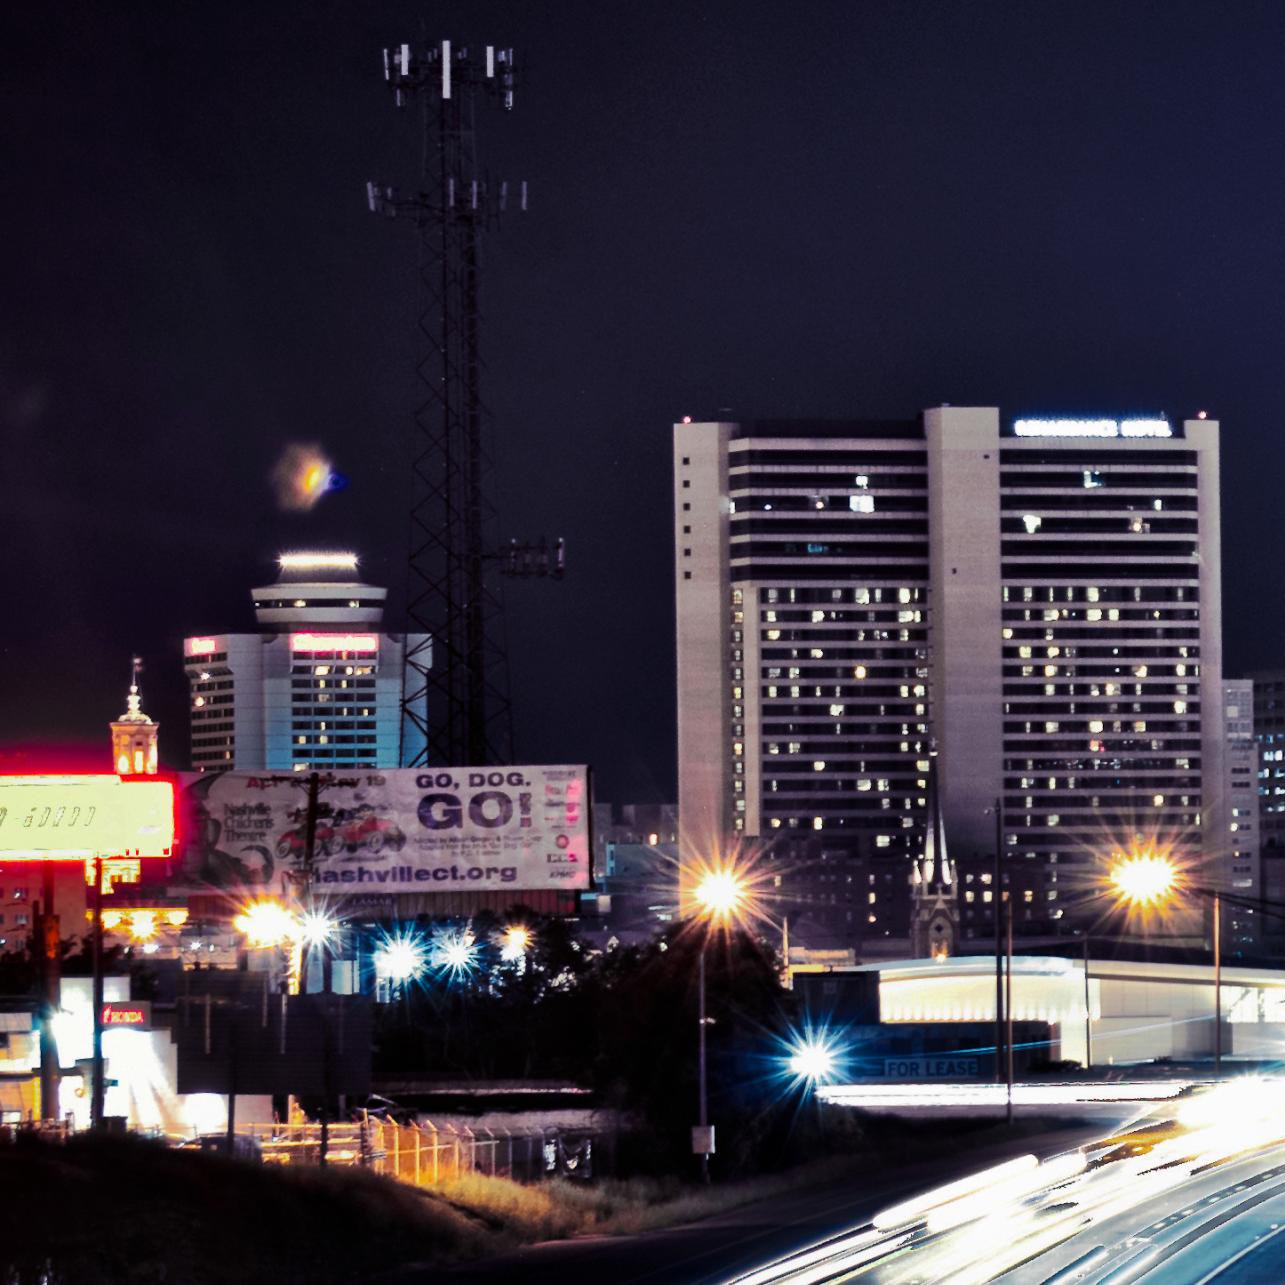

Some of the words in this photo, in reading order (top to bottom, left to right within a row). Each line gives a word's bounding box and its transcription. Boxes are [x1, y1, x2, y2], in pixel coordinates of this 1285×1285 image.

[416, 773, 460, 790] GO,
[469, 772, 531, 787] DOG.
[417, 791, 532, 830] GO!
[888, 1061, 919, 1076] FOR
[926, 1060, 977, 1076] LEASE
